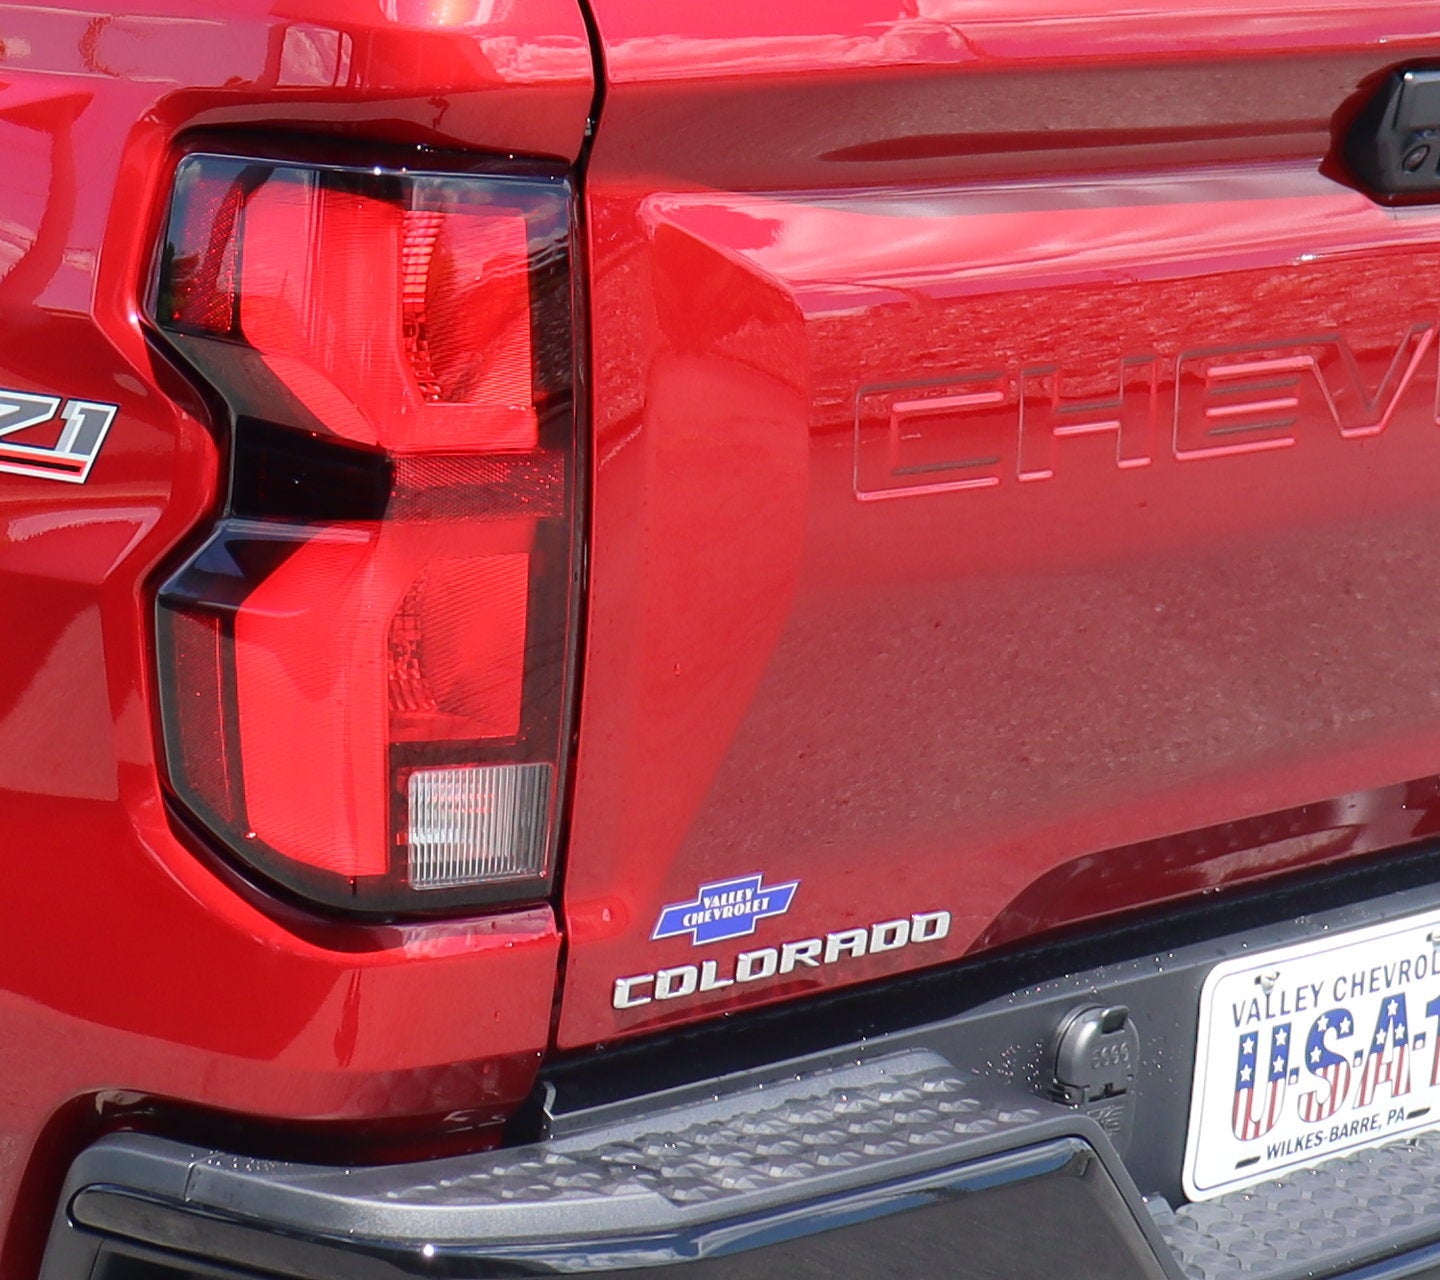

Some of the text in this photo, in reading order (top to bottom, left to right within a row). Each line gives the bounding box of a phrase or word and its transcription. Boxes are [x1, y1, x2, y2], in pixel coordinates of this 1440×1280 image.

[682, 896, 771, 928] CHEVROLET
[702, 887, 755, 910] VALLEY
[613, 910, 952, 1010] COLORADO
[1231, 980, 1325, 1028] VALLEY
[1386, 1106, 1406, 1126] PA
